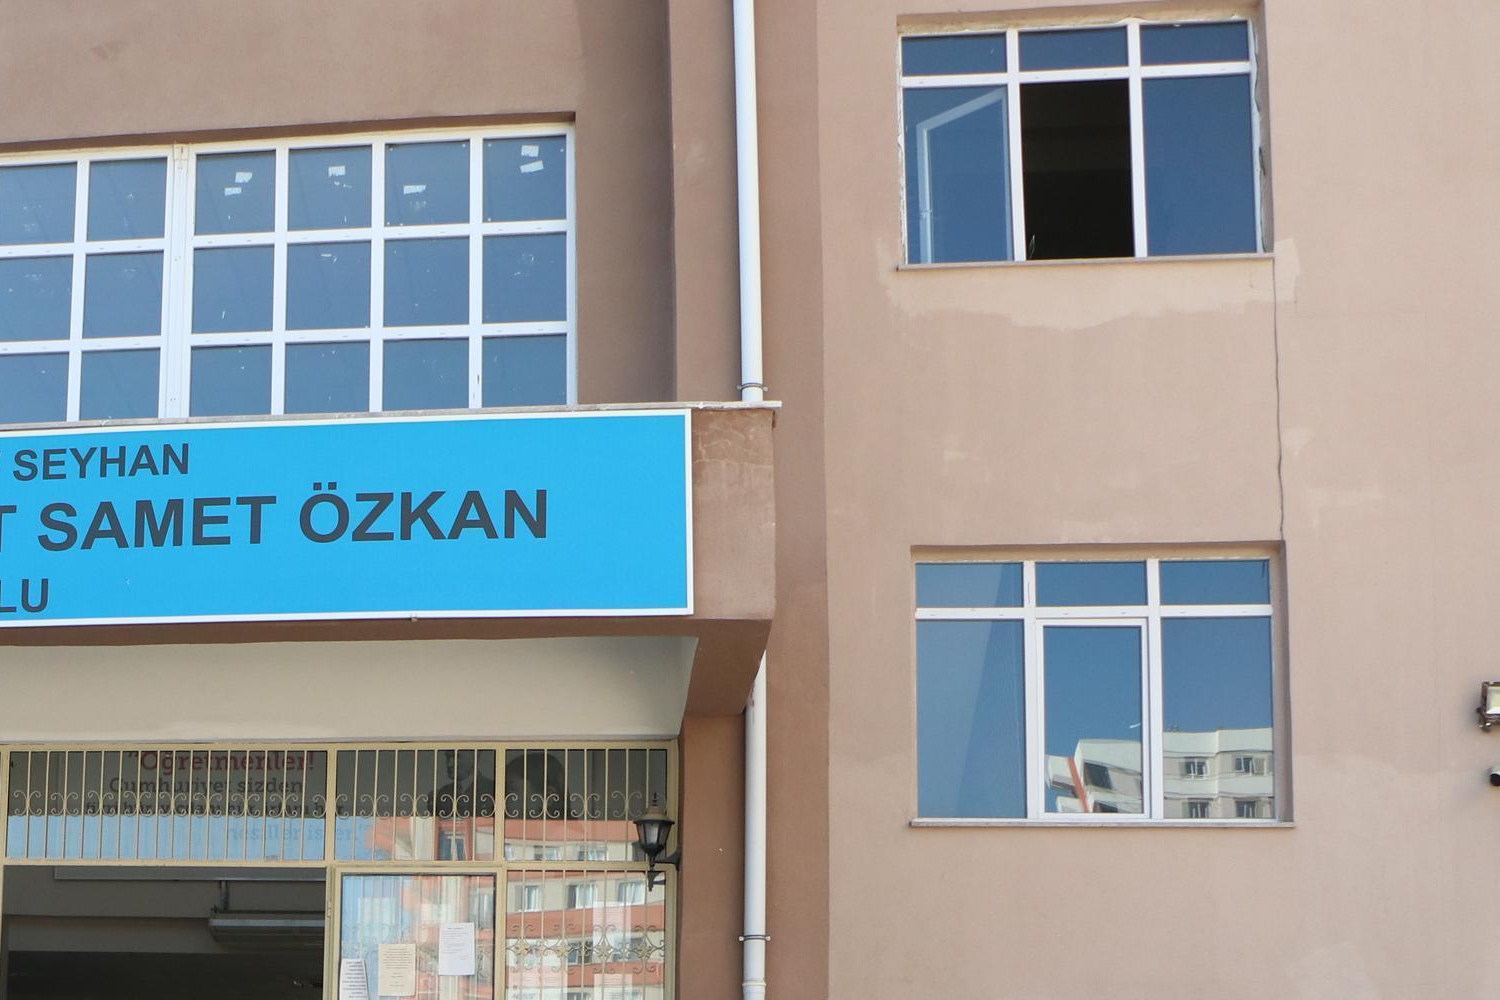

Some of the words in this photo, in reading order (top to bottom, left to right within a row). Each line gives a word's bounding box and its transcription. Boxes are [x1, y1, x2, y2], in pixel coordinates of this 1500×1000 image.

[12, 443, 190, 482] SEYHAN
[37, 495, 277, 553] SAMET
[299, 481, 547, 544] ÖZKAN
